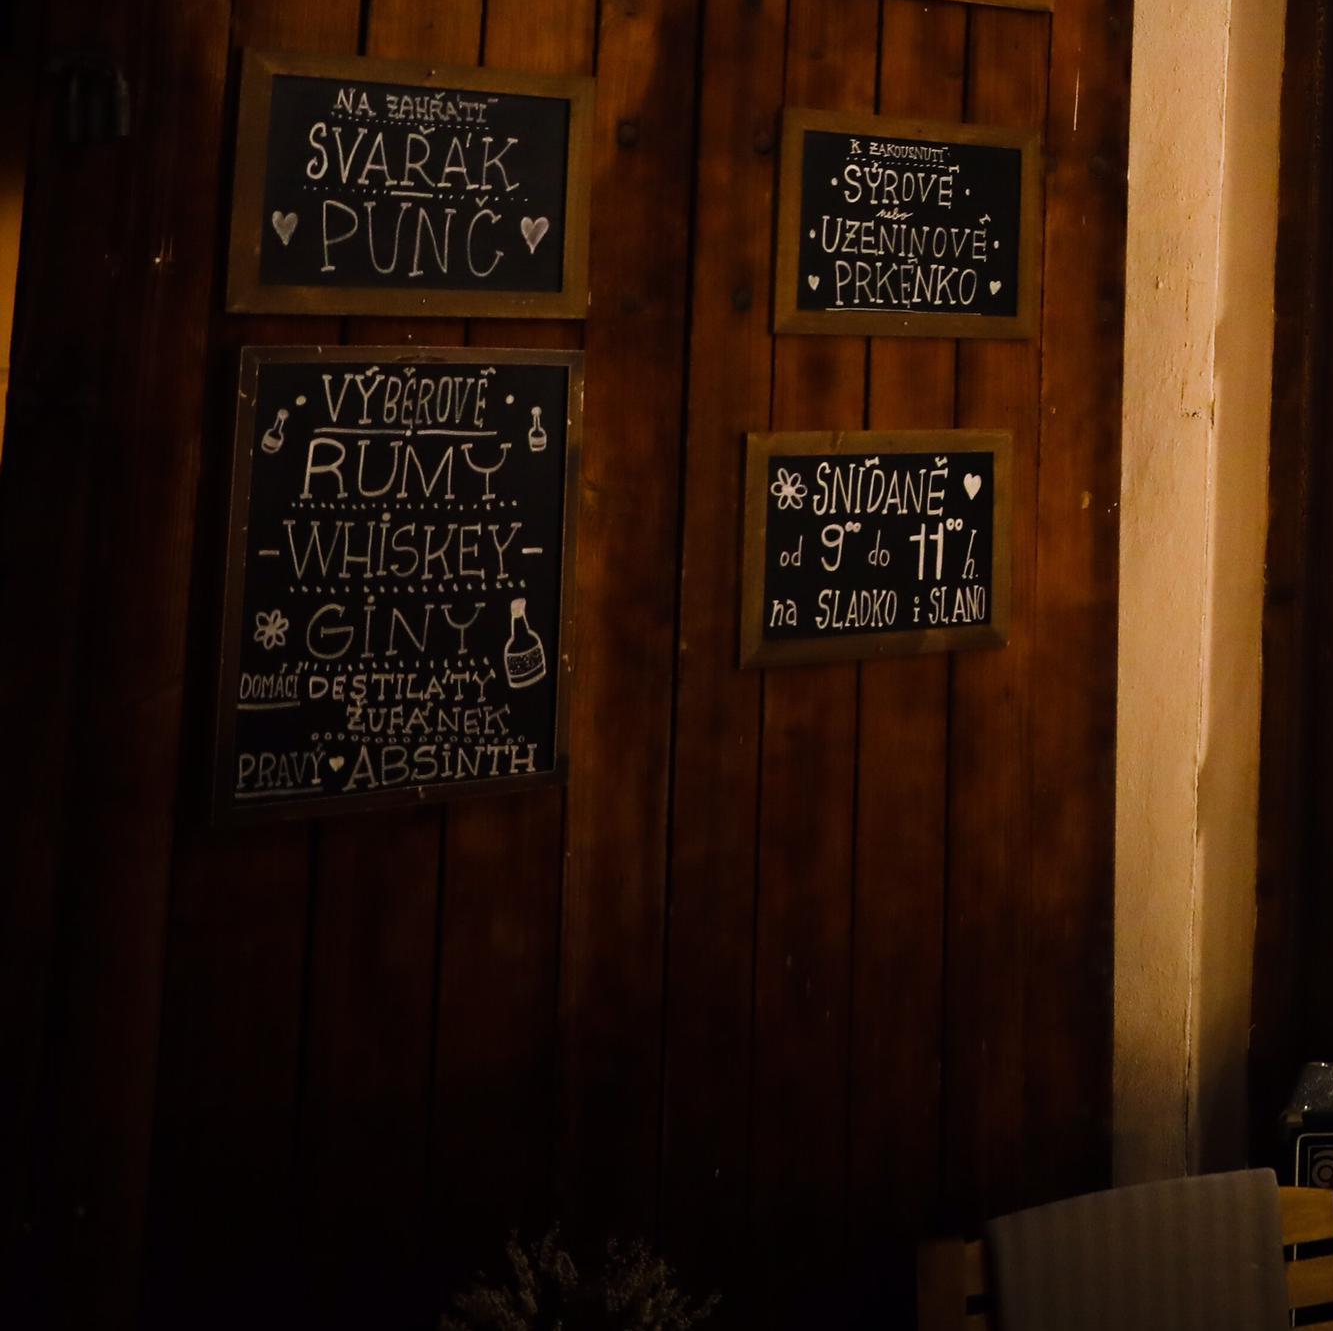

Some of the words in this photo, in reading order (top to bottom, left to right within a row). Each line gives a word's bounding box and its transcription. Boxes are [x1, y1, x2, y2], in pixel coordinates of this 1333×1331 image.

[333, 87, 376, 117] NA
[306, 122, 519, 192] SVAŘÁK
[850, 139, 862, 154] K
[844, 162, 959, 209] SÝROVÉ
[321, 196, 504, 278] PUNČ
[876, 208, 913, 220] nebo
[821, 214, 991, 262] UZENINOVÉ
[835, 258, 978, 308] PRKÉNKO
[322, 365, 497, 427] VÝBĚROVÉ
[300, 437, 512, 500] RUMY
[813, 456, 949, 517] SNÍDANĚ
[780, 535, 802, 567] od
[868, 530, 891, 567] do
[770, 599, 798, 627] na
[815, 589, 898, 630] SLADKO
[928, 585, 986, 624] SLANO
[239, 662, 303, 700] DOMÁCÍ
[308, 668, 496, 703] DESTILÁTY
[237, 743, 326, 789] PRAVÝ
